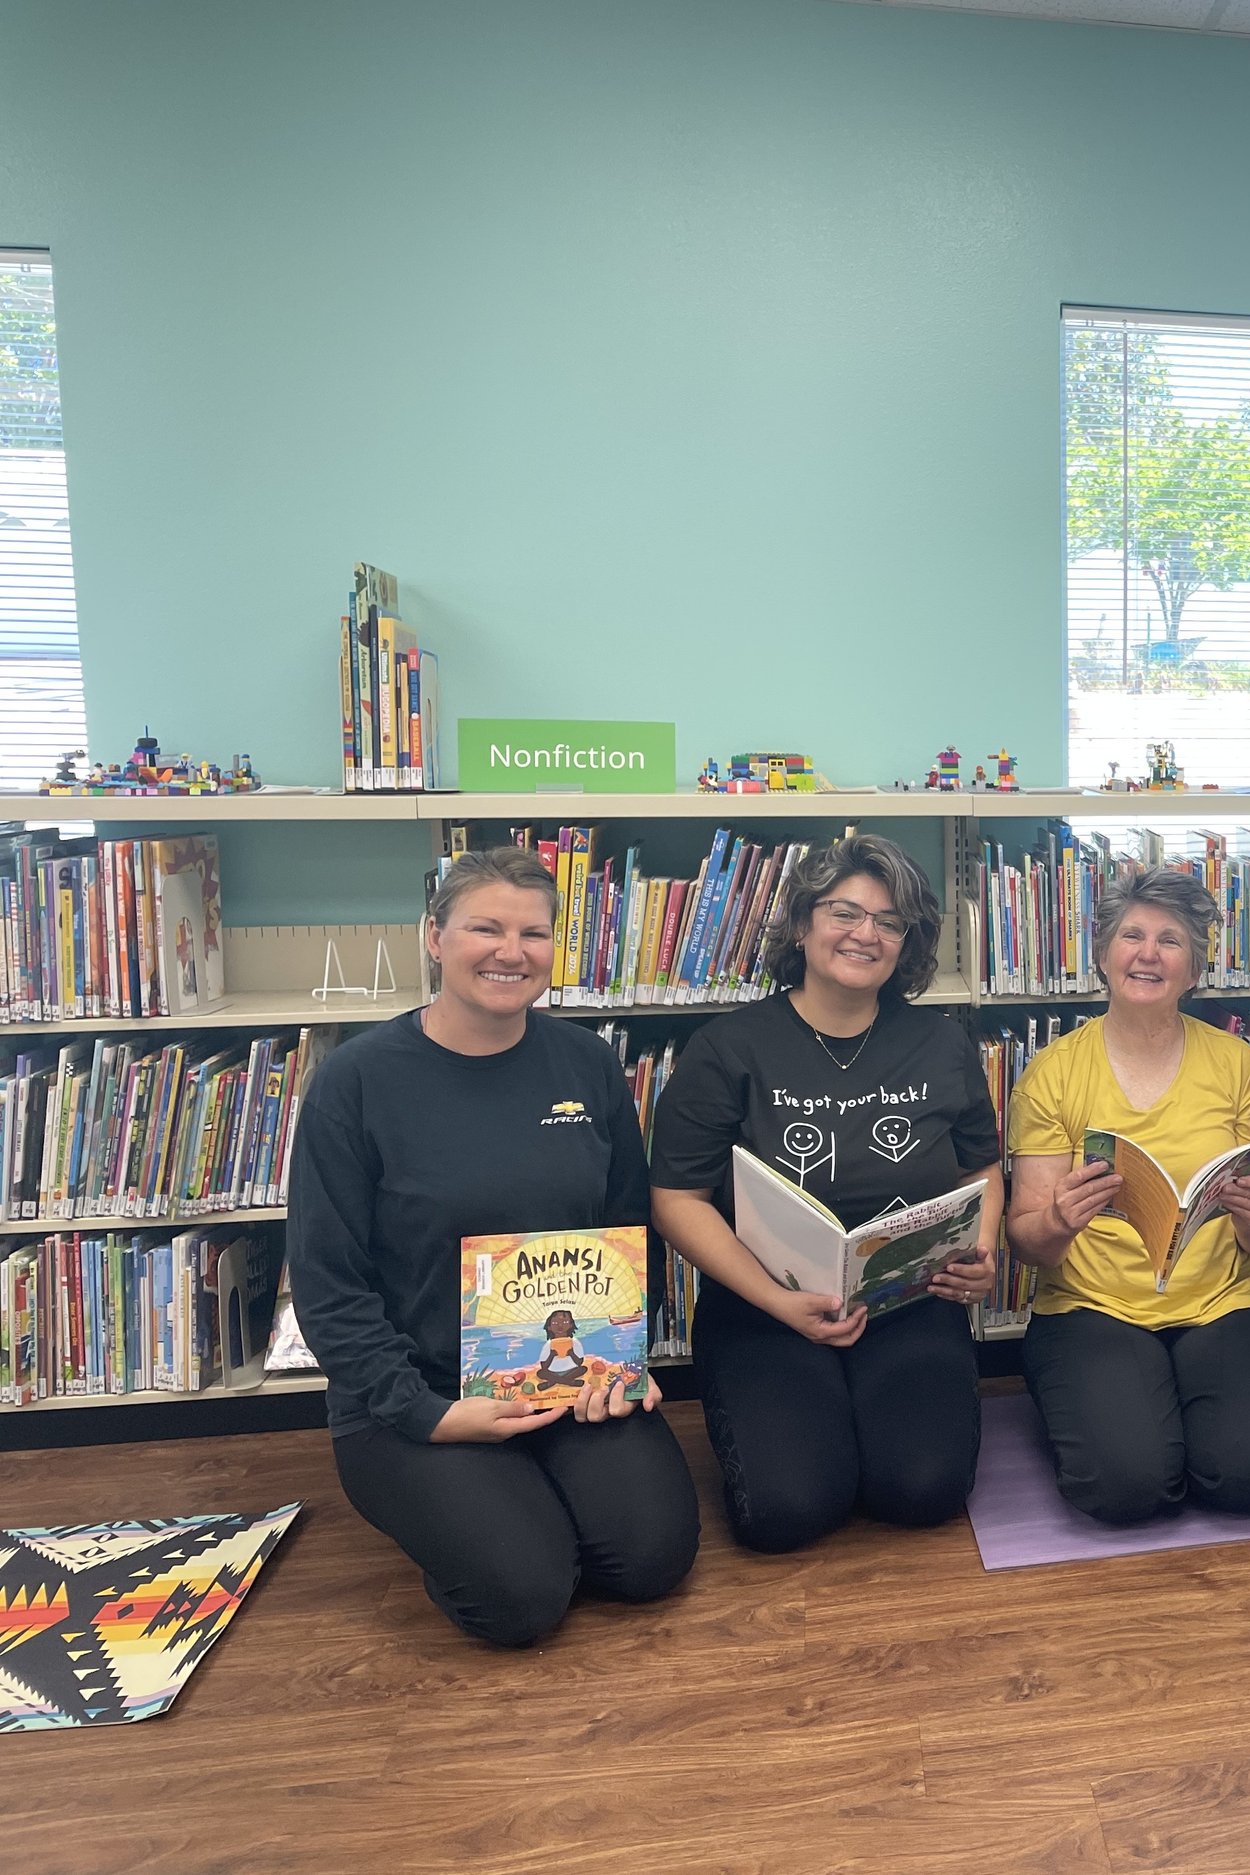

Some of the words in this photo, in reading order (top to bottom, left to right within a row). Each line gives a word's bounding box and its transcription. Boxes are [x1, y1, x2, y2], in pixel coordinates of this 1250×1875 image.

[490, 744, 645, 769] Nonfiction
[574, 863, 583, 884] weird
[702, 878, 715, 897] THIS
[696, 907, 707, 921] MY
[700, 898, 710, 906] IS
[569, 919, 579, 952] WORLD
[664, 912, 676, 944] DOUBLE
[688, 922, 703, 954] WORLD
[660, 948, 670, 970] LUCK
[772, 1089, 799, 1108] I've
[803, 1095, 832, 1116] got
[837, 1094, 877, 1116] your
[880, 1082, 928, 1105] back!
[883, 1217, 903, 1228] The
[906, 1202, 941, 1219] Rabbit
[913, 1209, 949, 1225] Rabbit
[890, 1226, 911, 1236] and
[517, 1248, 602, 1280] ANANSI
[502, 1272, 580, 1304] GOLDEN
[584, 1273, 615, 1296] POT
